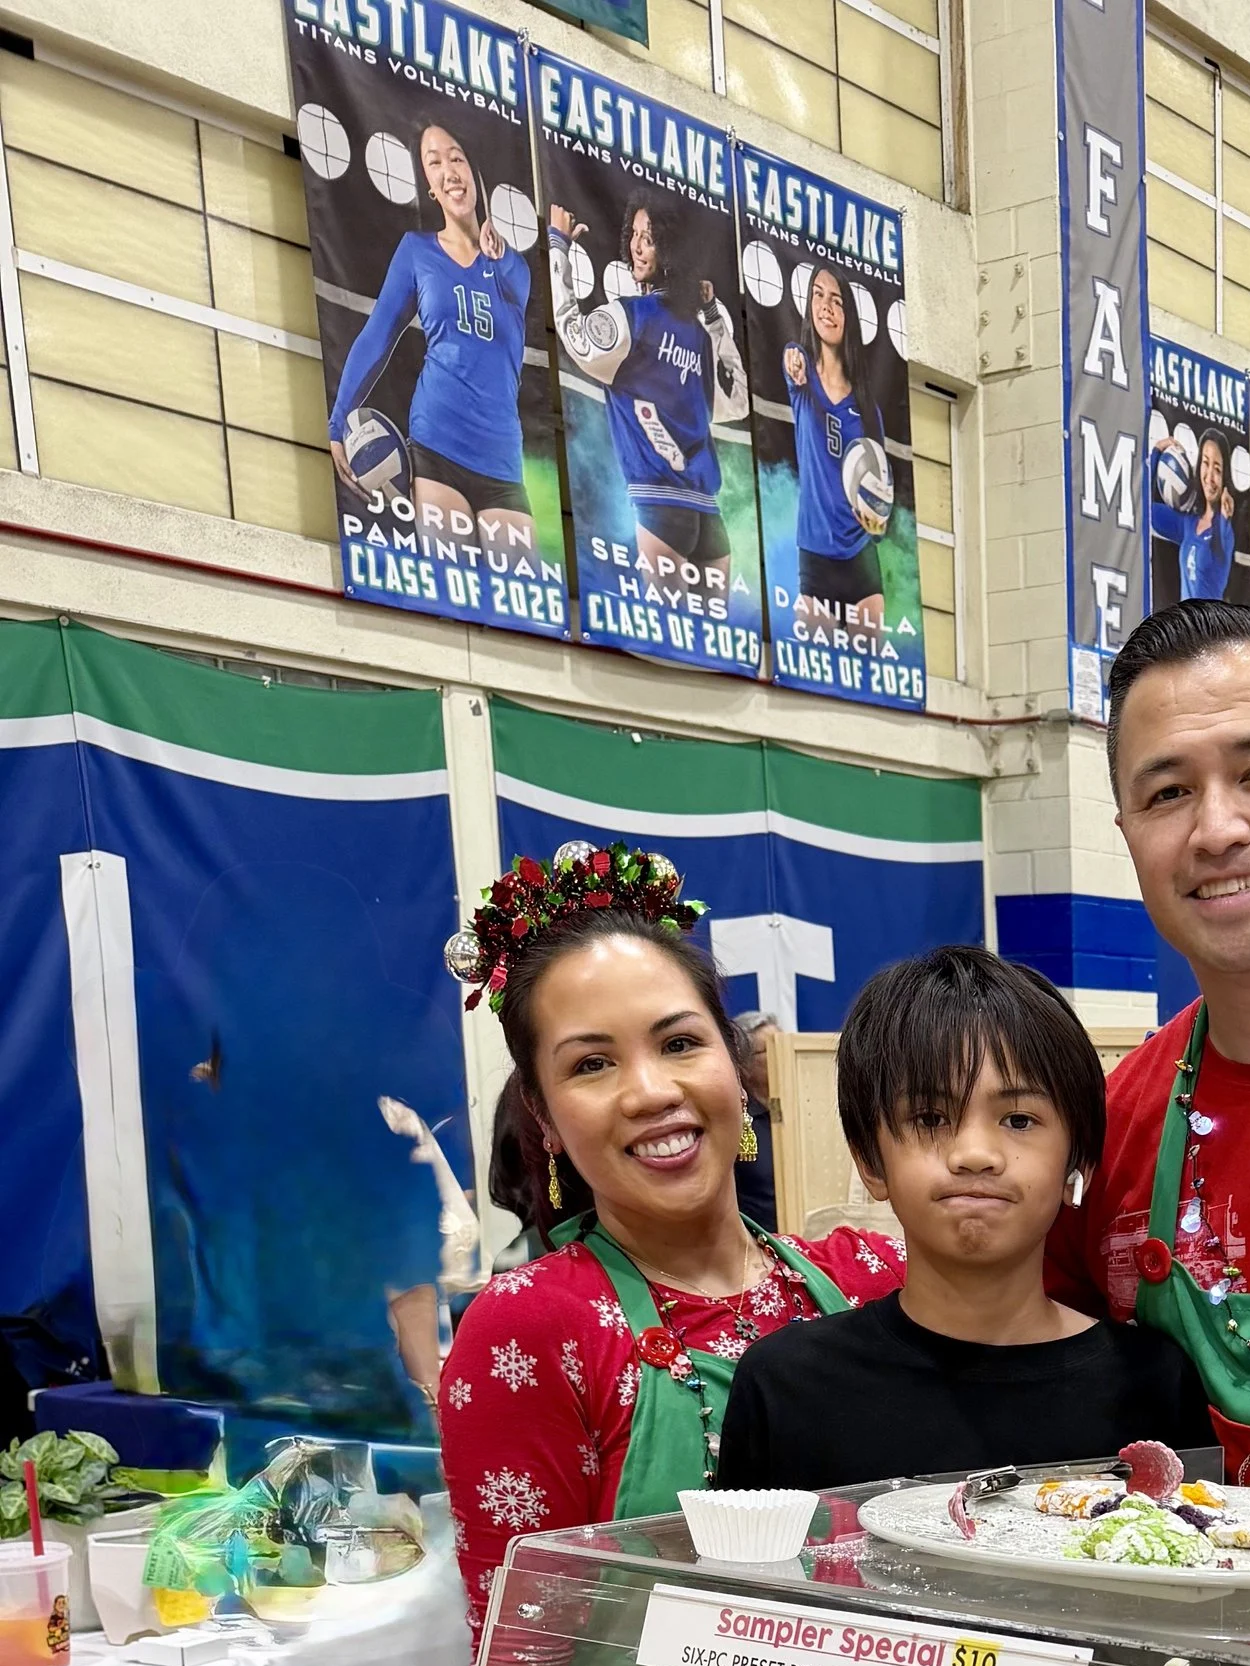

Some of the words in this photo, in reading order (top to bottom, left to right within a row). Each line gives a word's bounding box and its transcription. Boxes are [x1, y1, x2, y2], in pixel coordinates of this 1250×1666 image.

[295, 18, 376, 64] TITANS
[388, 57, 521, 125] VOLLEYBALL
[540, 64, 726, 196] EASTLAKE
[542, 126, 612, 163] TITANS
[620, 157, 729, 213] VOLLEYBALL
[744, 158, 899, 270] EASTLAKE
[746, 213, 799, 246] TITANS
[806, 239, 901, 285] VOLLEYBALL
[454, 285, 493, 341] 15
[658, 331, 702, 385] Hayes
[1150, 346, 1246, 421] ASTLAKE
[1182, 401, 1246, 435] VOLLEYBALL
[343, 514, 563, 584] PAMINTUAN
[368, 489, 532, 549] JORDYN
[350, 544, 438, 600] CLASS
[446, 567, 481, 609] OF
[491, 577, 564, 624] 2026
[591, 537, 750, 596] SEAPORA
[619, 575, 728, 620] HAYES
[774, 585, 917, 636] DANIELLA
[588, 594, 663, 643] CLASS
[667, 613, 694, 651] OF
[702, 621, 760, 665] 2026
[793, 620, 899, 660] GARCIA
[776, 640, 834, 683] CLASS
[839, 655, 862, 689] OF
[869, 661, 923, 699] 2026
[717, 1608, 833, 1649] Sampler
